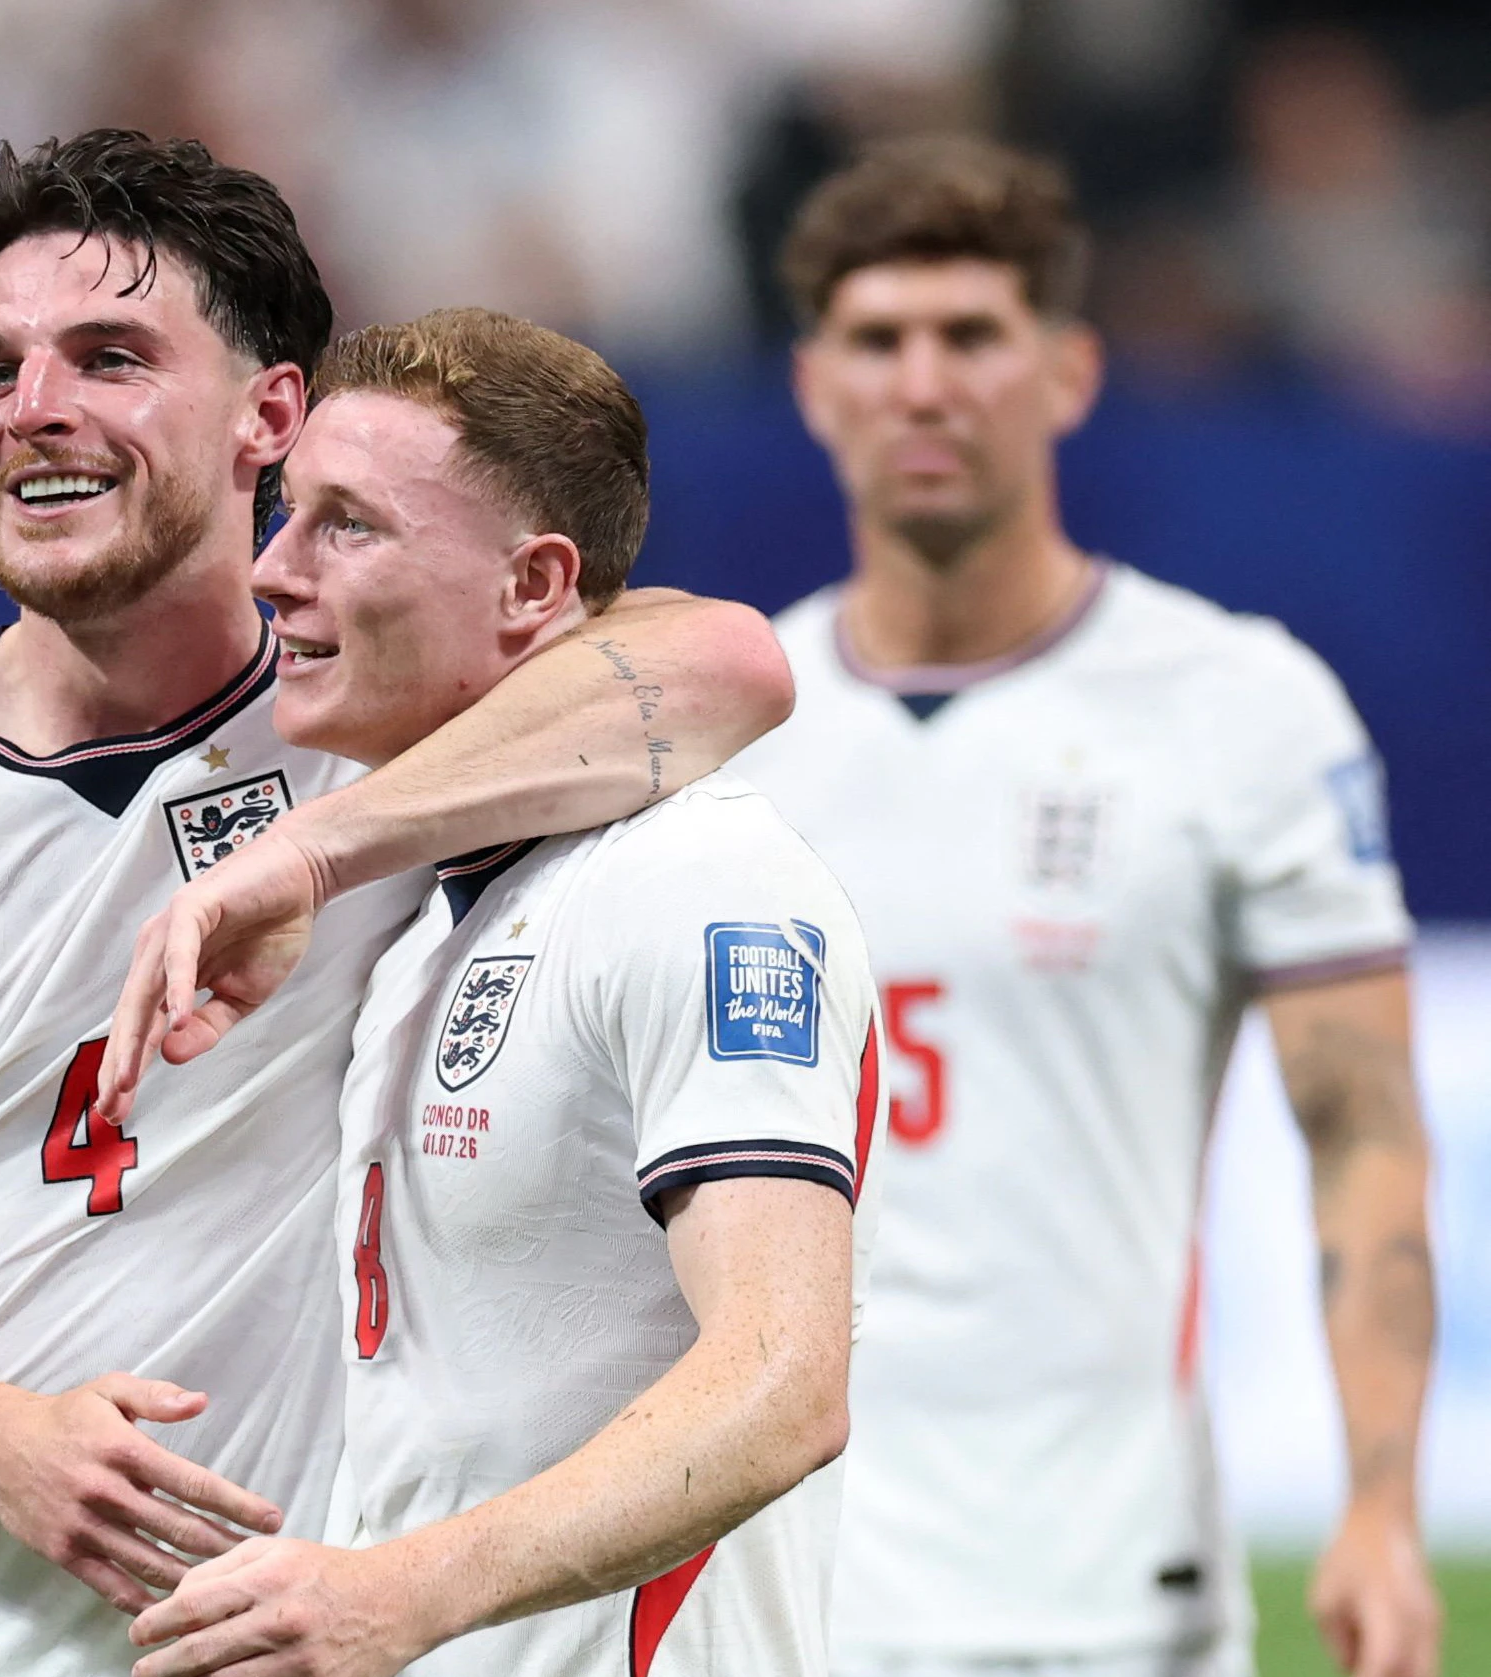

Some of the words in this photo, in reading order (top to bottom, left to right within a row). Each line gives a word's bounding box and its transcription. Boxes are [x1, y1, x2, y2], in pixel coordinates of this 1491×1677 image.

[632, 685, 663, 721] Else
[729, 945, 803, 971] FOOTBALL
[730, 966, 804, 1001] UNITES
[725, 995, 757, 1021] the
[760, 997, 806, 1029] World
[752, 1023, 784, 1038] FIFA
[882, 978, 949, 1154] 5
[41, 1034, 138, 1217] 4
[422, 1104, 464, 1128] CONGO
[467, 1107, 490, 1131] DR
[422, 1132, 477, 1159] 01.07.26
[354, 1161, 389, 1360] 8
